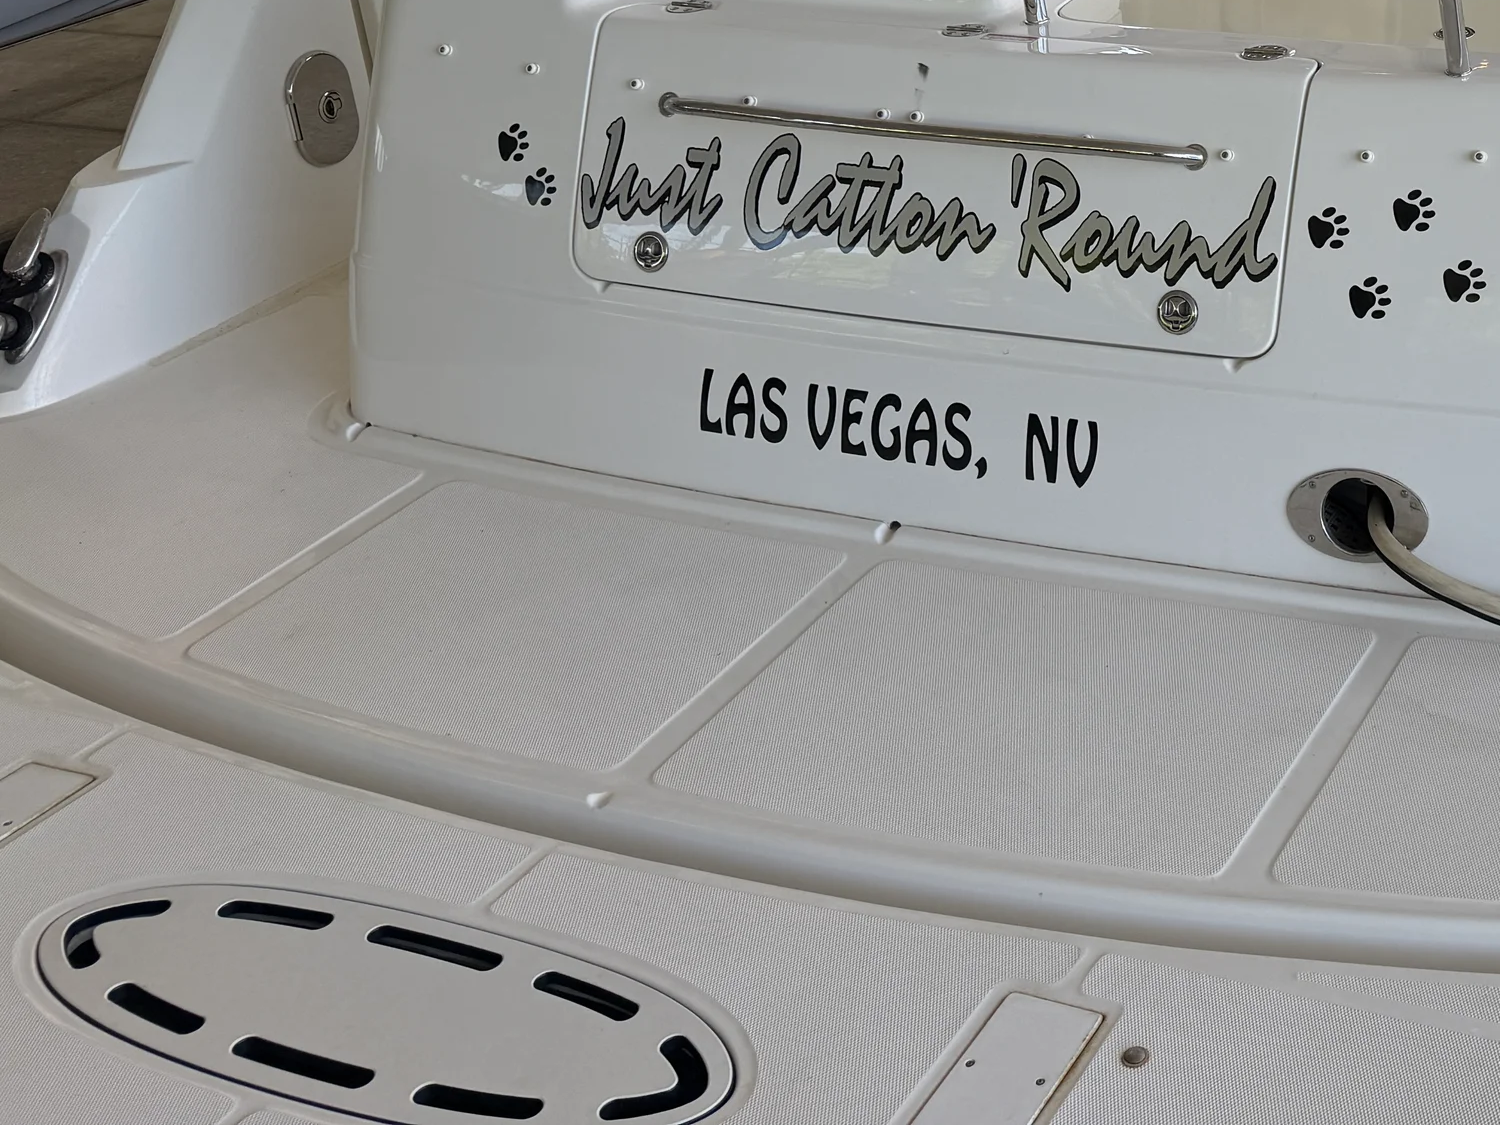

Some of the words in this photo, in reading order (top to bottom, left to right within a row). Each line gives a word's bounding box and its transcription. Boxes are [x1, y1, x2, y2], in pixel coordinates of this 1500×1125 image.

[580, 116, 724, 236] Just
[743, 132, 997, 263] Catton
[1010, 152, 1279, 293] 'Round
[700, 368, 788, 444] LAS
[807, 383, 988, 480] VEGAS,
[1025, 412, 1099, 489] NV
